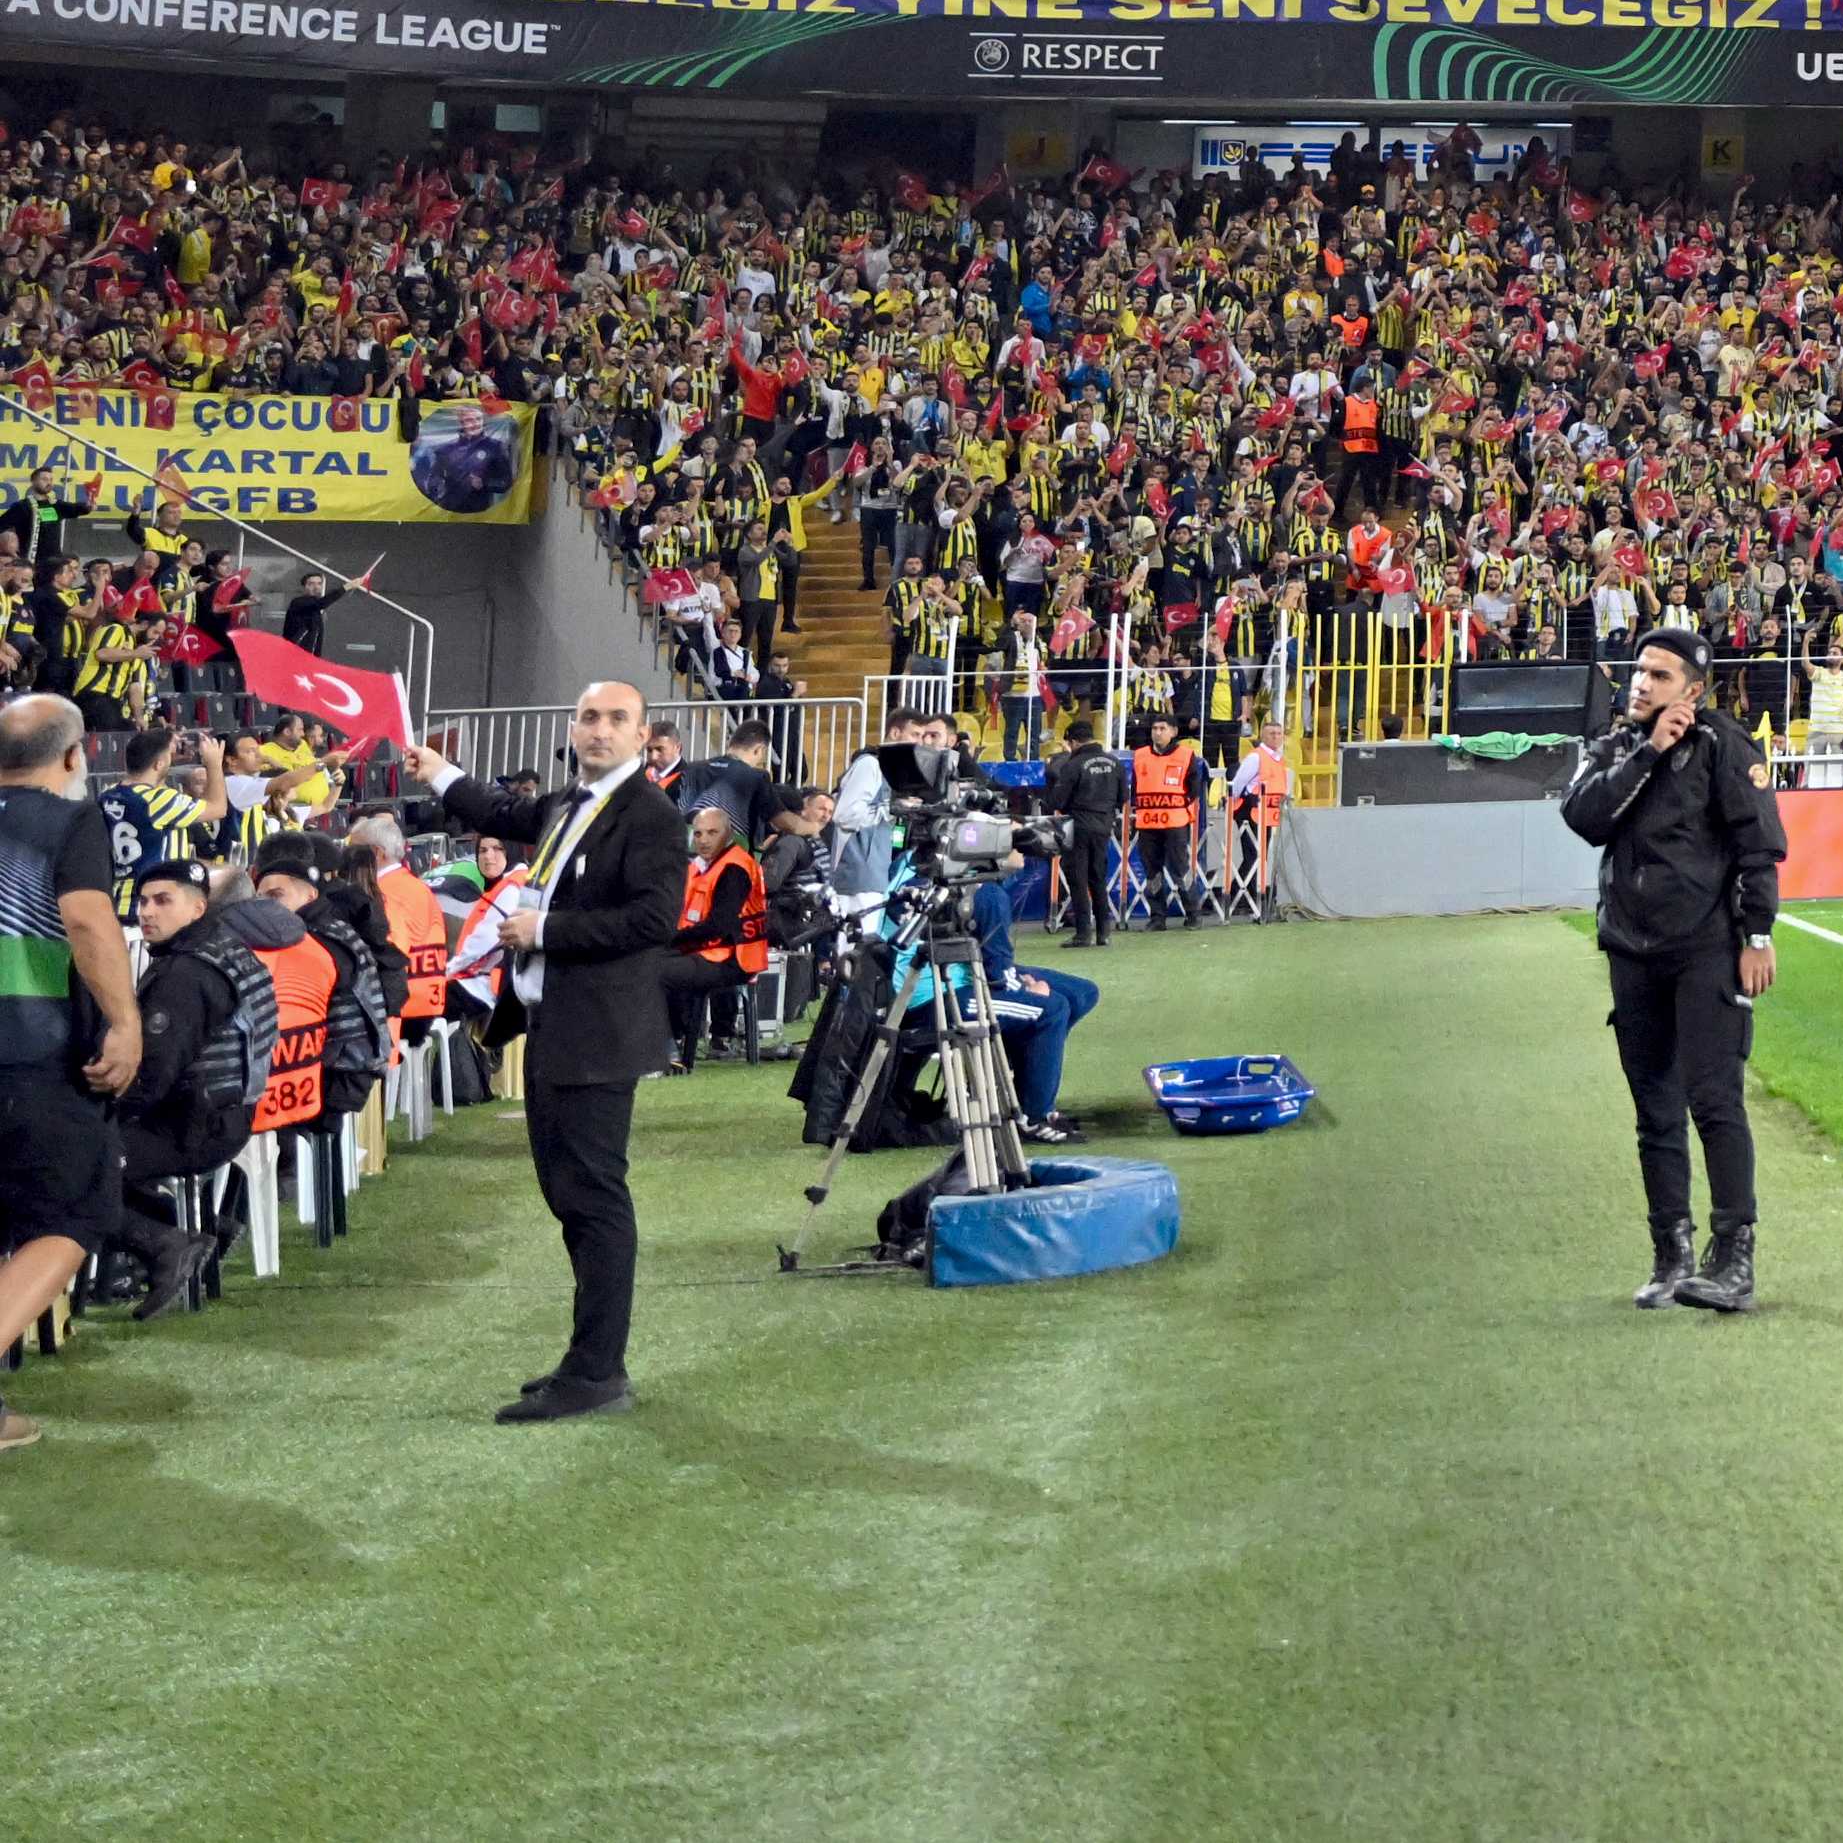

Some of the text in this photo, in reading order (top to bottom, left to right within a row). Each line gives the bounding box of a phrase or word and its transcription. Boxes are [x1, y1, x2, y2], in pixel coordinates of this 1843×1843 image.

[1022, 44, 1164, 72] RESPECT
[156, 446, 388, 476] KARTAL
[188, 485, 318, 514] GFB
[1143, 812, 1170, 825] 040
[264, 1075, 316, 1116] 382
